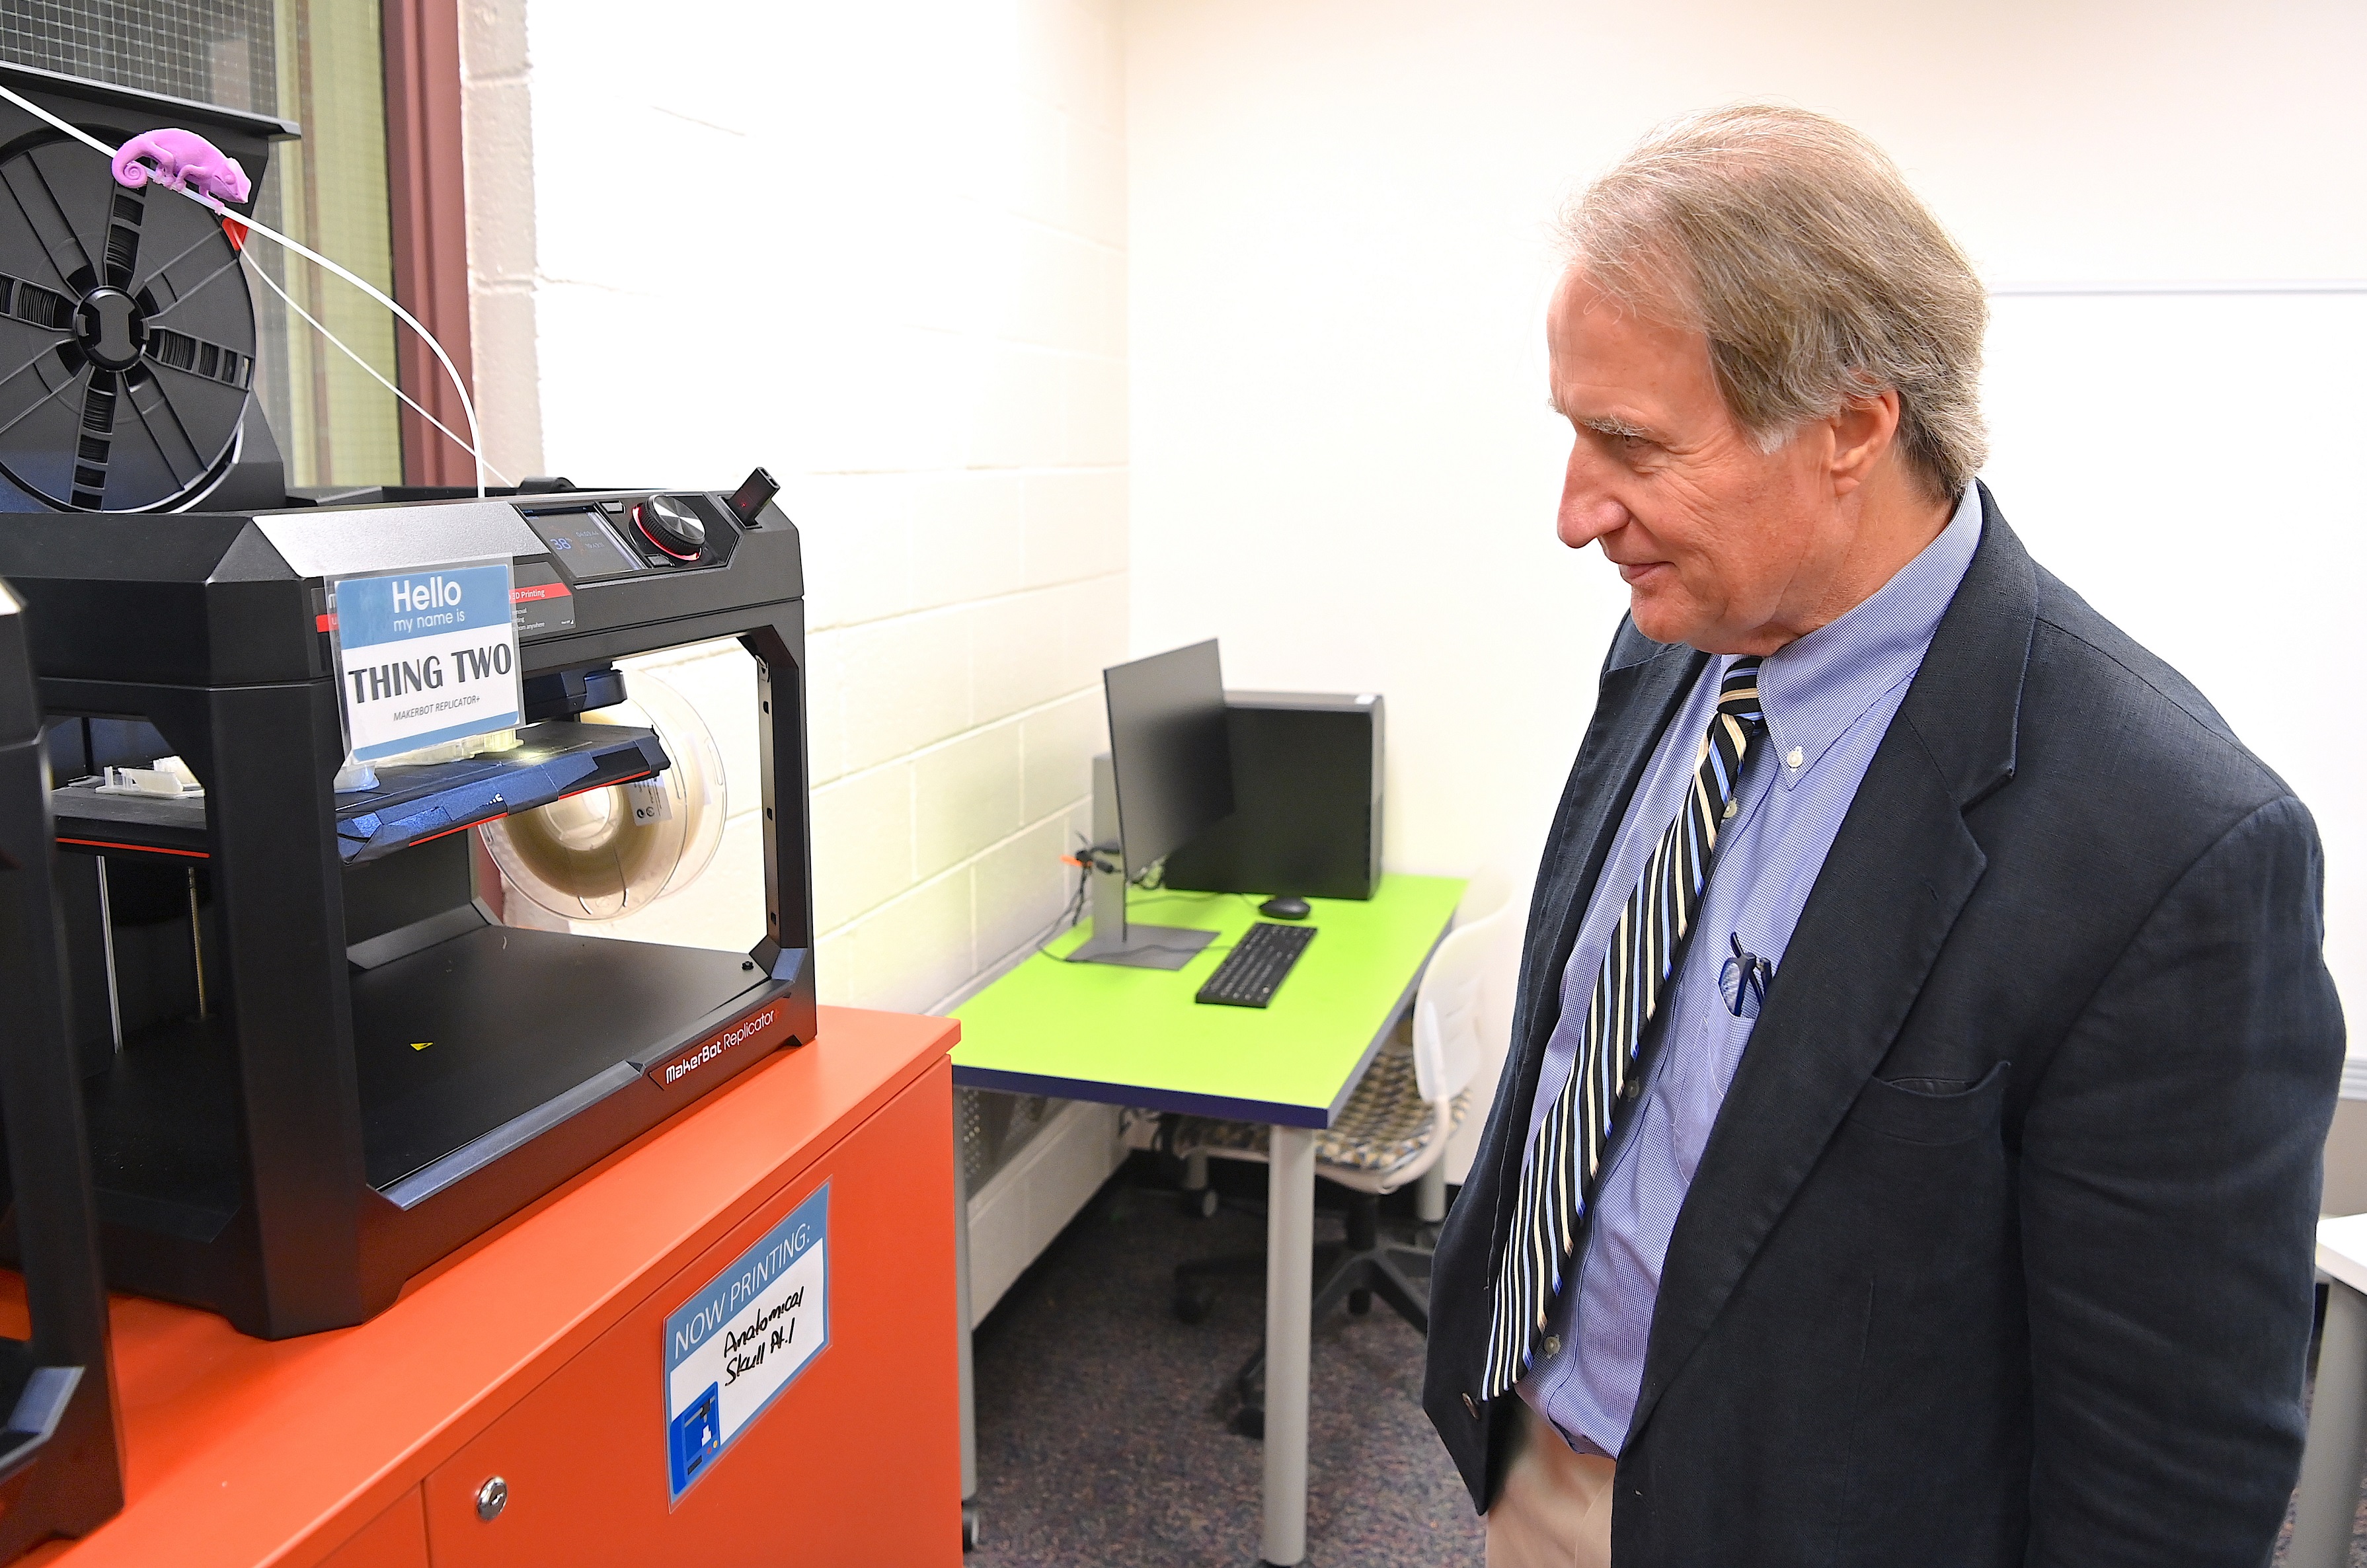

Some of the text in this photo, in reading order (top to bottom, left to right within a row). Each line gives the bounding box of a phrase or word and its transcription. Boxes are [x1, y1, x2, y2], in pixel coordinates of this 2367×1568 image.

[392, 576, 461, 613] Hello
[522, 589, 545, 598] Printing
[393, 608, 465, 633] my name is
[348, 643, 512, 704] THING TWO
[393, 695, 480, 721] MAKERBOT REPLICATOR+
[666, 1040, 722, 1084] MakerBot
[675, 1223, 810, 1360] NOW PRINTING:
[724, 1286, 804, 1358] Anatomical
[724, 1342, 765, 1387] Skull
